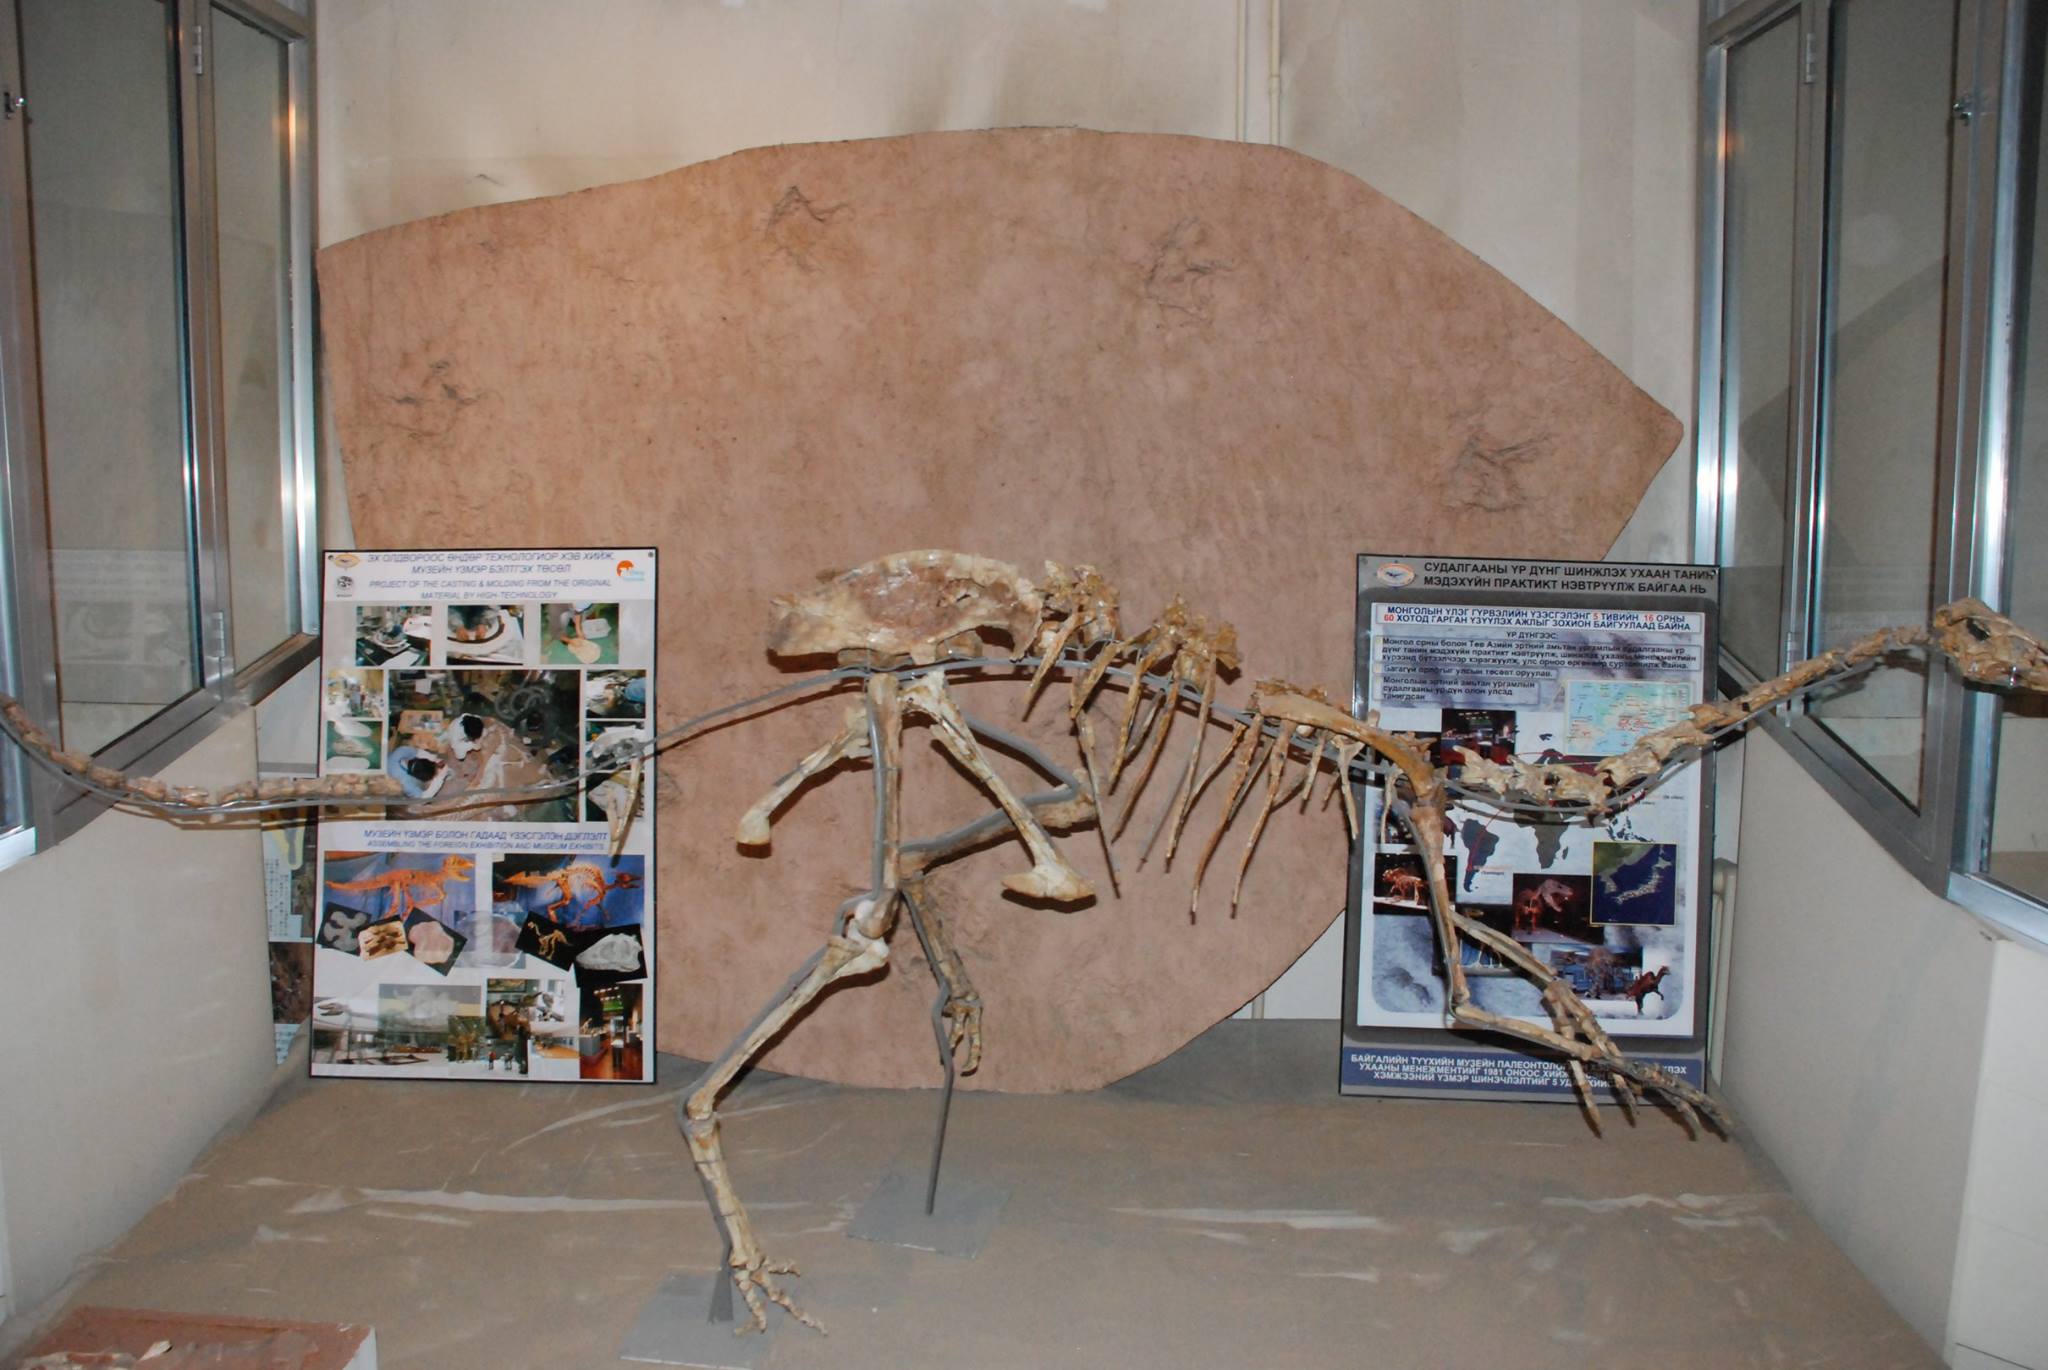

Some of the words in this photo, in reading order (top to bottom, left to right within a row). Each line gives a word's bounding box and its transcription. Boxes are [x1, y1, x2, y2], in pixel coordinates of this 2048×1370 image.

[486, 553, 558, 561] ТЕХНОЛОГИОР
[411, 565, 451, 574] МУЗЕЙН
[1424, 562, 1508, 574] СУДАЛГААНЫ
[1511, 565, 1526, 574] ҮР
[1530, 565, 1561, 576] ДҮНГ
[1564, 567, 1627, 577] ШИНЖЛЭХ
[1630, 568, 1670, 578] УХААН
[1674, 570, 1714, 580] ТАНИН
[369, 580, 406, 588] PROJECT
[408, 580, 420, 588] OF
[423, 580, 437, 588] THE
[441, 580, 476, 588] CASTING
[486, 580, 525, 588] MOLDING
[526, 580, 551, 588] FROM
[554, 579, 570, 587] THE
[572, 579, 612, 588] ORIGINAL
[1424, 576, 1490, 588] МЭДЭХҮЙН
[1494, 578, 1561, 589] ПРАКТИКТ
[1562, 581, 1635, 592] НЭВТРҮҮЛЖ
[1638, 582, 1686, 593] БАЙГАА
[1690, 584, 1706, 594] НЬ
[421, 592, 461, 600] MATERIAL
[1387, 606, 1443, 615] МОНГОЛЫН
[1446, 607, 1469, 616] ҮЛЭГ
[1472, 608, 1528, 618] ГҮРВЭЛИЙН
[1530, 610, 1590, 620] ҮЗЭСГЭЛЭНГ
[1592, 612, 1599, 620] 5
[1601, 612, 1639, 622] ТИВИЙН
[1643, 614, 1654, 622] 16
[1656, 614, 1685, 623] ОРНЫ
[1384, 614, 1394, 622] 60
[1396, 614, 1429, 624] ХОТОД
[1431, 616, 1468, 624] ГАРГАН
[1470, 616, 1512, 626] ҮЗҮҮЛЭХ
[1514, 618, 1549, 626] АЖЛЫГ
[1552, 620, 1591, 628] ЗОХИОН
[1594, 620, 1656, 630] БАЙГУУЛААД
[1658, 622, 1690, 630] БАЙНА
[1382, 638, 1414, 646] Монгол
[1416, 640, 1438, 648] орны
[363, 830, 401, 838] МУЗЕЙН
[470, 831, 507, 840] ГАДААД
[1351, 1054, 1409, 1064] БАЙГАЛИЙН
[1411, 1056, 1454, 1066] ТҮҮХИЙН
[1456, 1058, 1495, 1068] МУЗЕЙН
[1359, 1062, 1400, 1072] УХААНЫ
[1402, 1064, 1480, 1074] МЕНЕЖМЕНТИЙГ
[1506, 1068, 1540, 1078] ОНООС
[1374, 1071, 1435, 1081] ХЭМЖЭЭНИЙ
[1437, 1074, 1468, 1082] ҮЗМЭР
[1471, 1076, 1549, 1086] ШИНЭЧЛЭЛТИЙГ
